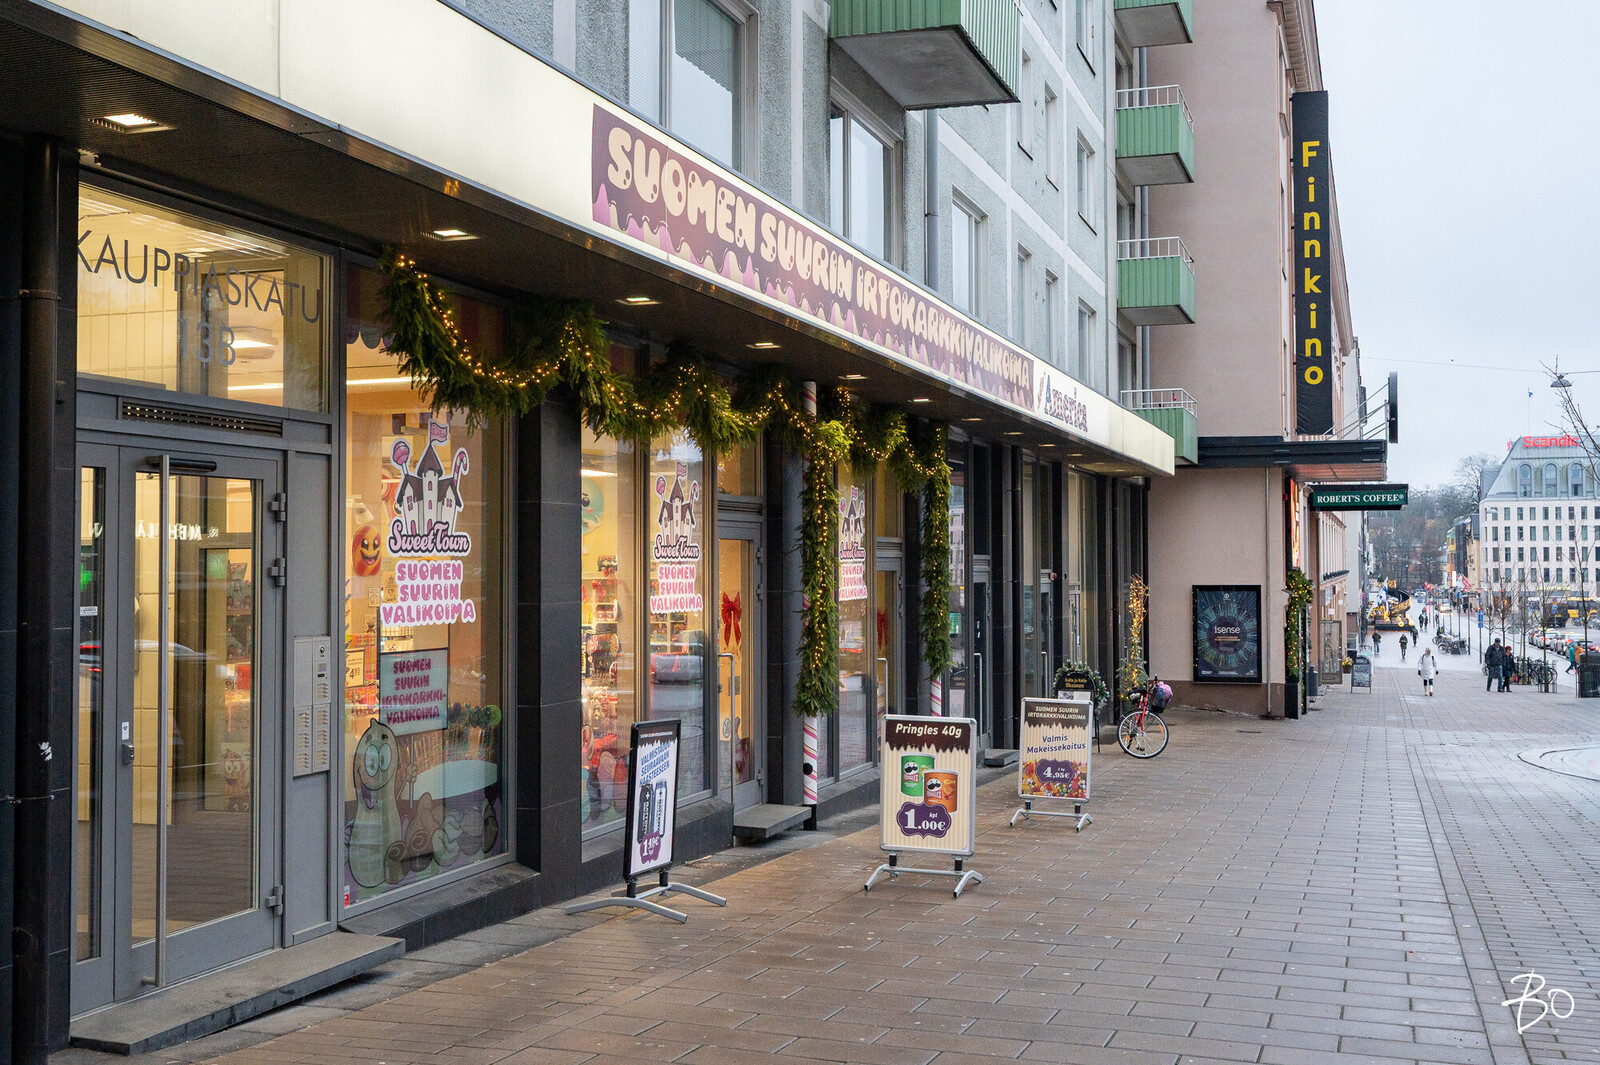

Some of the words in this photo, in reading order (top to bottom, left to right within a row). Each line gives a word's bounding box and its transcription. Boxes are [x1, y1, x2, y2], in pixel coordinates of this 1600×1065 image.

[608, 127, 756, 253] SUOMEN
[760, 212, 852, 301] SUURIN
[856, 265, 1030, 390] IRTOKARKKIVALIKOIMA
[1302, 140, 1324, 385] Finnkino
[77, 230, 320, 323] KAUPPIASKATU
[178, 317, 236, 366] 13B
[1044, 374, 1088, 432] America
[1523, 434, 1579, 448] Scandic
[1316, 494, 1360, 503] ROBERT'S
[389, 518, 435, 553] Sweet
[433, 521, 470, 553] Town
[654, 534, 680, 559] Sweet
[678, 535, 700, 559] Town
[397, 563, 462, 581] SUOMEN
[658, 566, 695, 580] SUOMEN
[842, 565, 863, 576] SUOMEN
[660, 581, 694, 595] SUURIN
[843, 577, 862, 587] SUURIN
[400, 583, 459, 602] SUURIN
[651, 595, 703, 611] VALIKOIMA
[382, 602, 475, 625] VALIKOIMA
[393, 658, 431, 675] SUOMEN
[394, 674, 430, 691] SUURIN
[381, 688, 447, 709] IRTOKARKKI-
[386, 706, 440, 725] VALIKOIMA
[1028, 712, 1086, 721] IRTOKARKKIVALIKOIMA
[895, 723, 939, 737] Pringles
[941, 725, 962, 738] 40g
[1042, 734, 1068, 743] Valmis
[1026, 742, 1086, 754] Makeissekoitus
[1043, 766, 1070, 779] 4,95€
[904, 808, 946, 831] 1.00€
